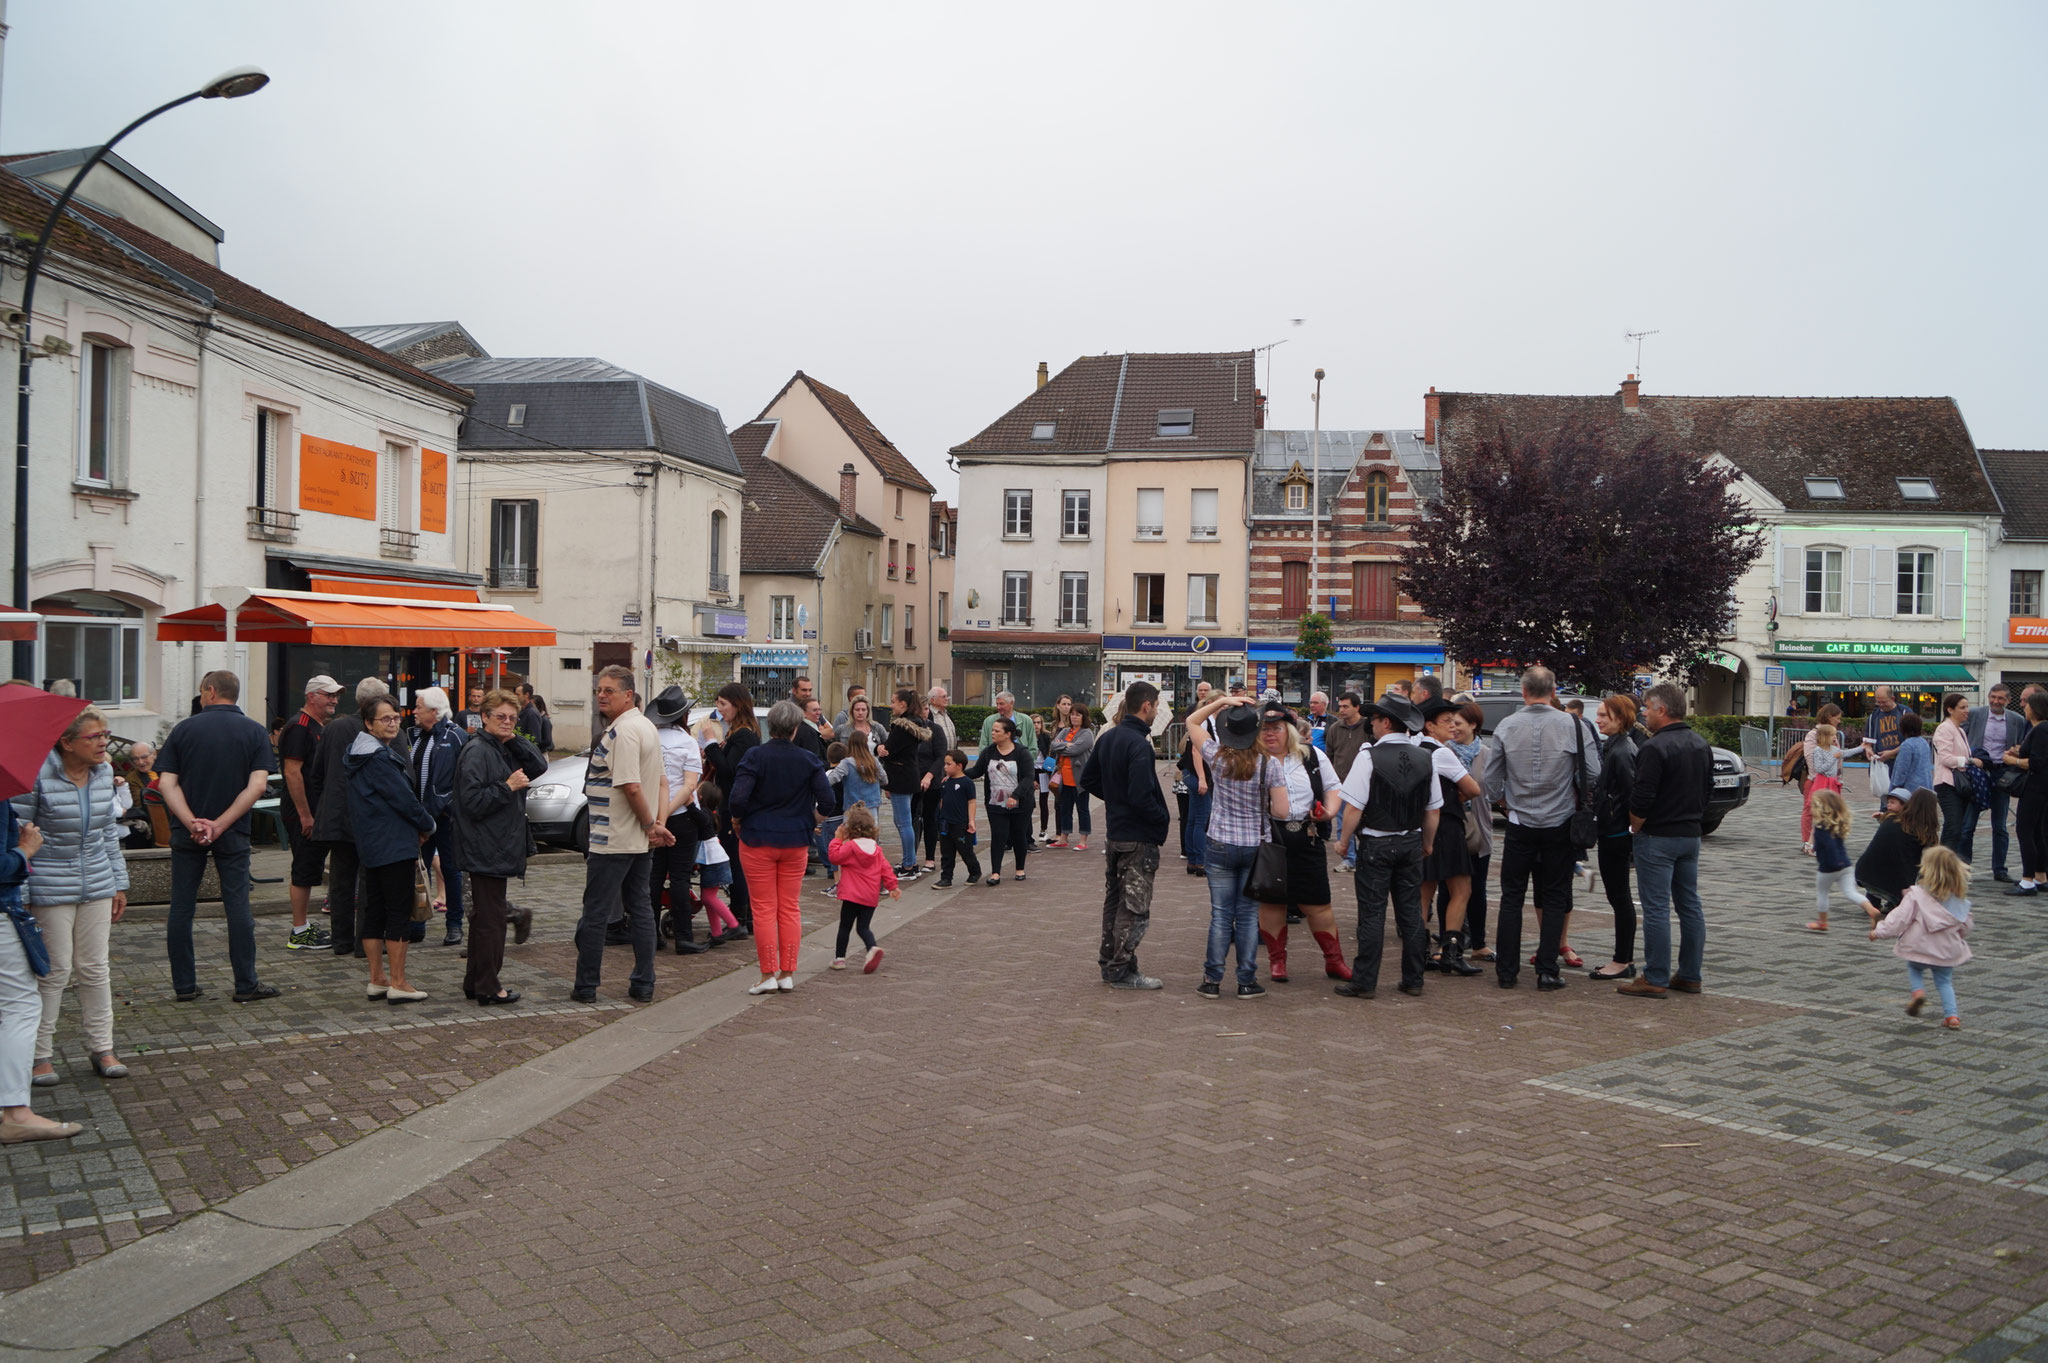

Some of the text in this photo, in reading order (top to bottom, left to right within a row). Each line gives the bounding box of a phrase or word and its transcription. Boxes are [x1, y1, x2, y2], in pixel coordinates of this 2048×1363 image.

[1779, 643, 1815, 652] Heineken
[1826, 643, 1910, 655] CAFE DU MARCHE
[1921, 646, 1957, 655] Heineken
[1794, 684, 1826, 692] Heineken
[1848, 684, 1869, 692] CAFE
